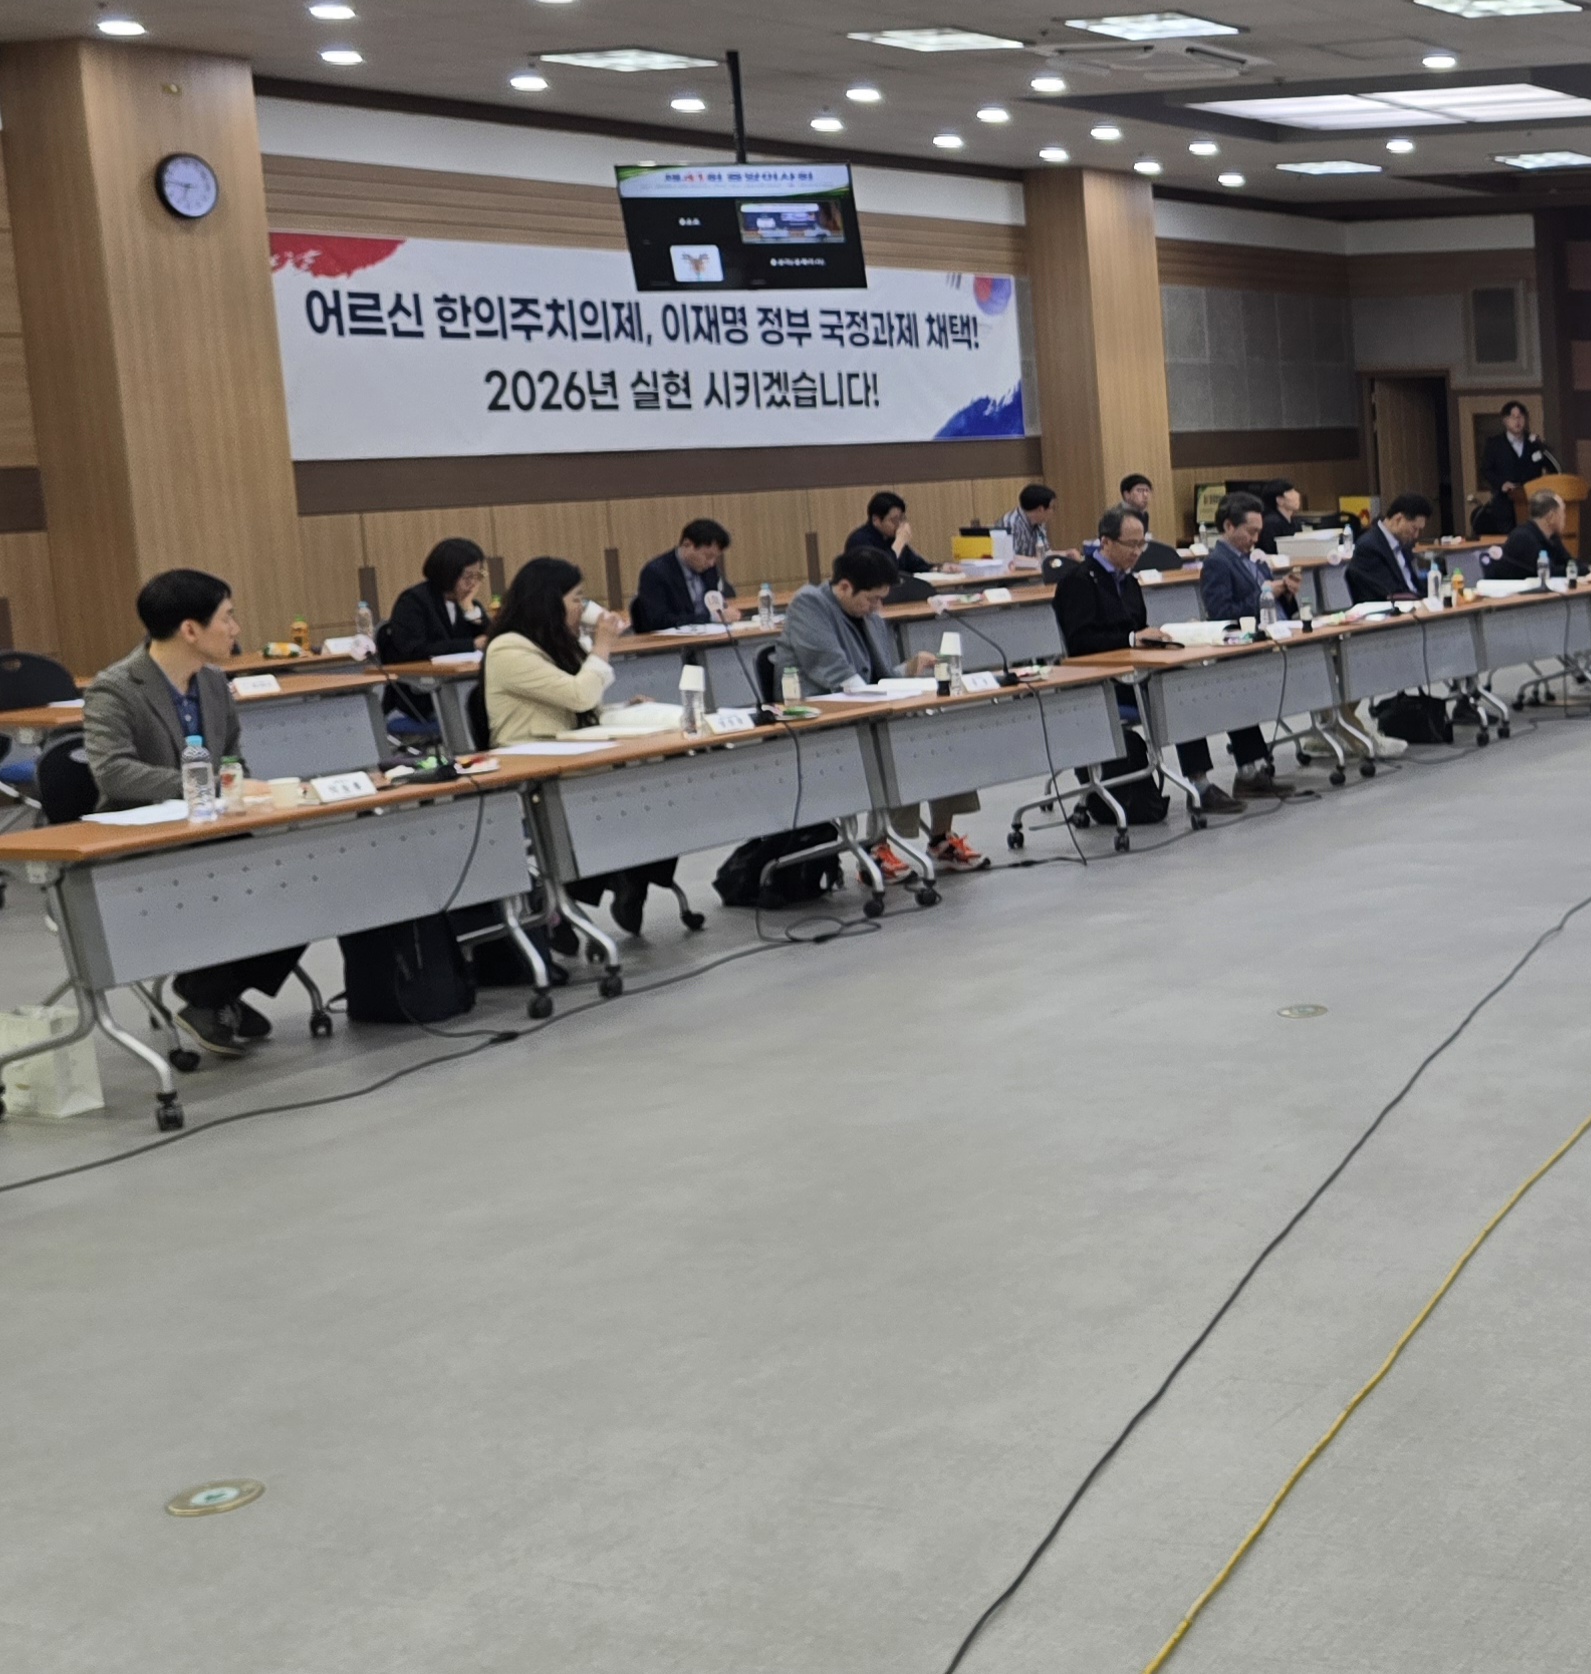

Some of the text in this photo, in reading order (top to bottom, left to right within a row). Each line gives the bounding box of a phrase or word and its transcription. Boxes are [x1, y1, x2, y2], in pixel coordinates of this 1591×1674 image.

[305, 289, 980, 351] 어르신 한의주치의제, 이재명 정부 국정과제 채택!
[485, 369, 881, 411] 2026년 실현 시키겠습니다!
